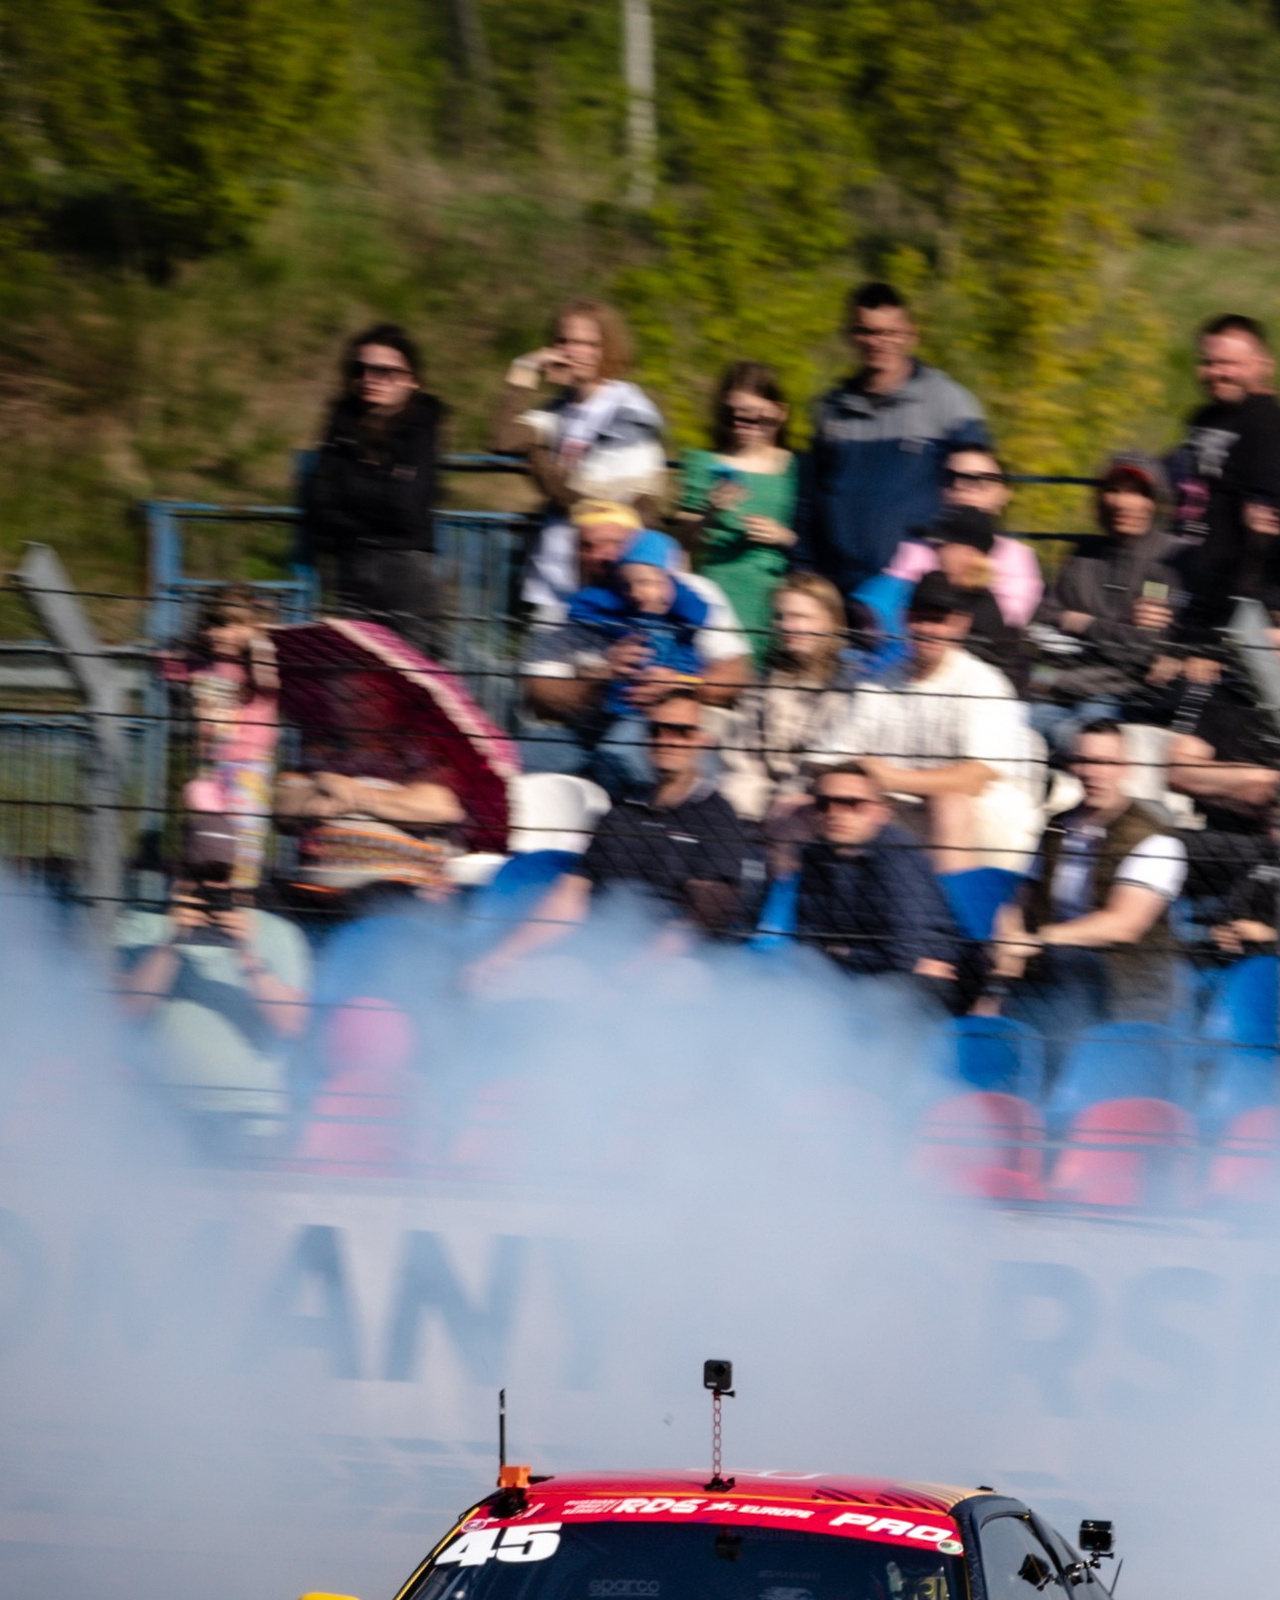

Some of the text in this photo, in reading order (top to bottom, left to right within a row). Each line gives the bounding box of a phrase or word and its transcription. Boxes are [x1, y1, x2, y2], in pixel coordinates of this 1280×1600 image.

[612, 1498, 708, 1514] RDS
[738, 1505, 816, 1520] EUROPE
[828, 1512, 954, 1542] PRO
[434, 1522, 563, 1567] 45
